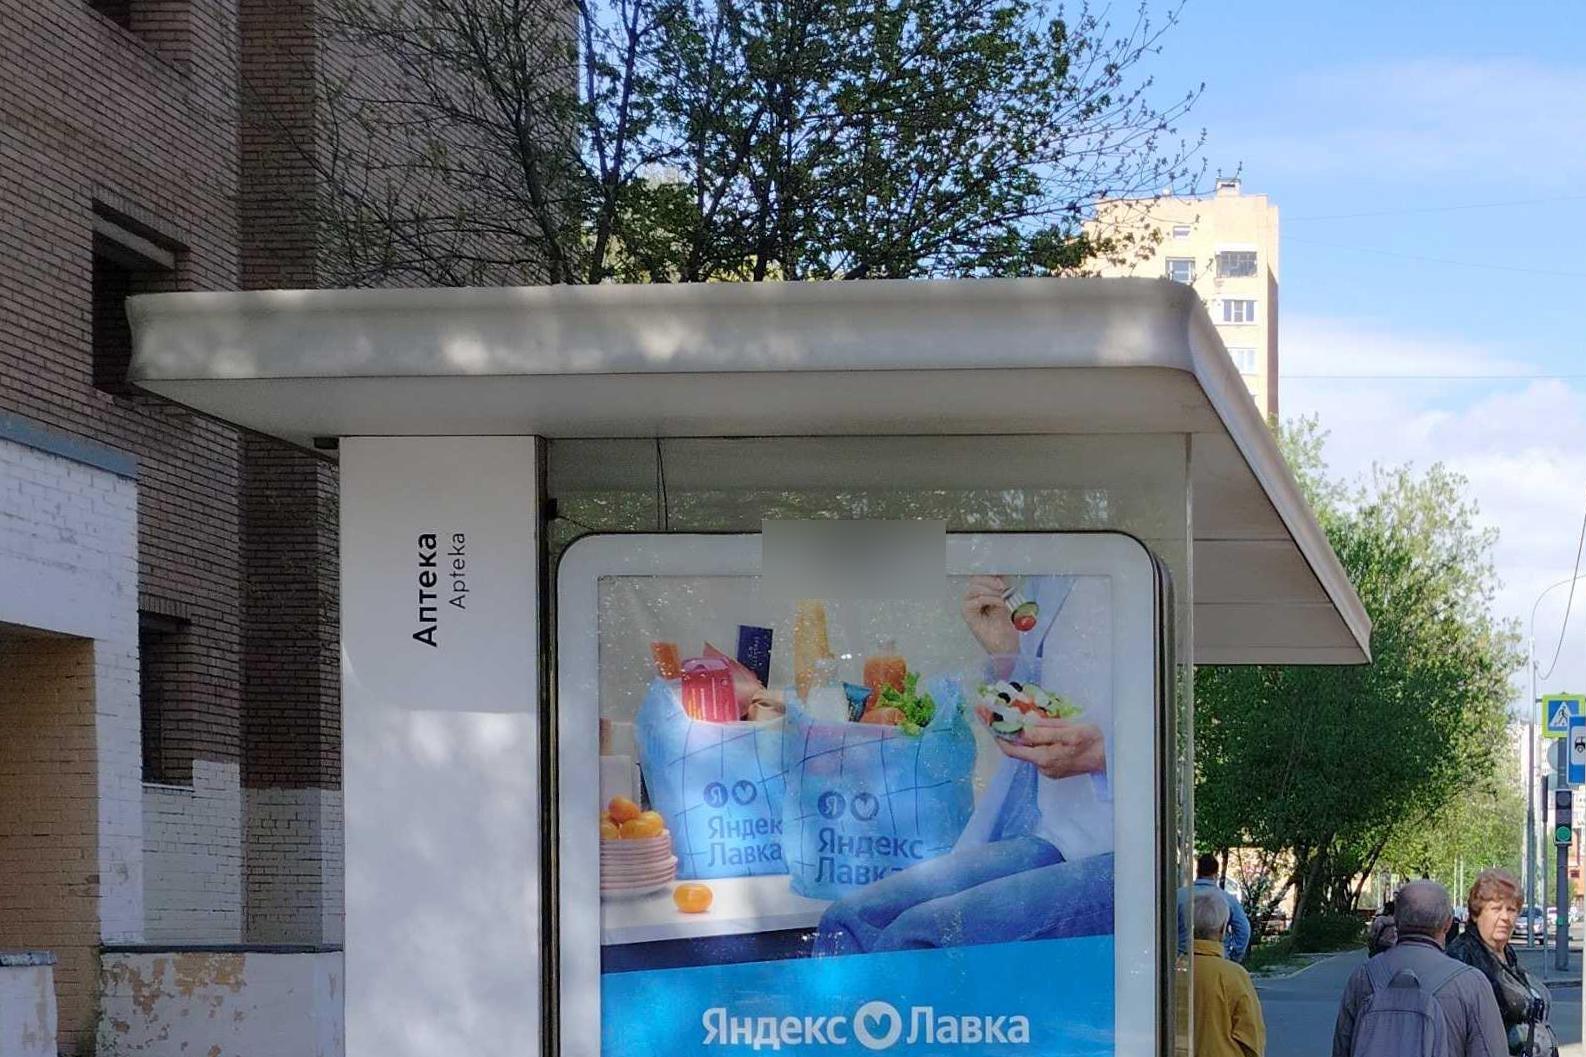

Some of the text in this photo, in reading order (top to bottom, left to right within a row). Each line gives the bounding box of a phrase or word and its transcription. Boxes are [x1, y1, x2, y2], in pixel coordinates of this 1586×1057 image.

[447, 532, 470, 610] Apteka
[412, 533, 438, 648] Аптека
[708, 815, 783, 840] Яндек
[818, 827, 924, 860] Яндекс
[708, 842, 783, 868] Лавка
[814, 857, 904, 885] Лавк
[702, 1006, 1030, 1050] Яндекс Лавка
